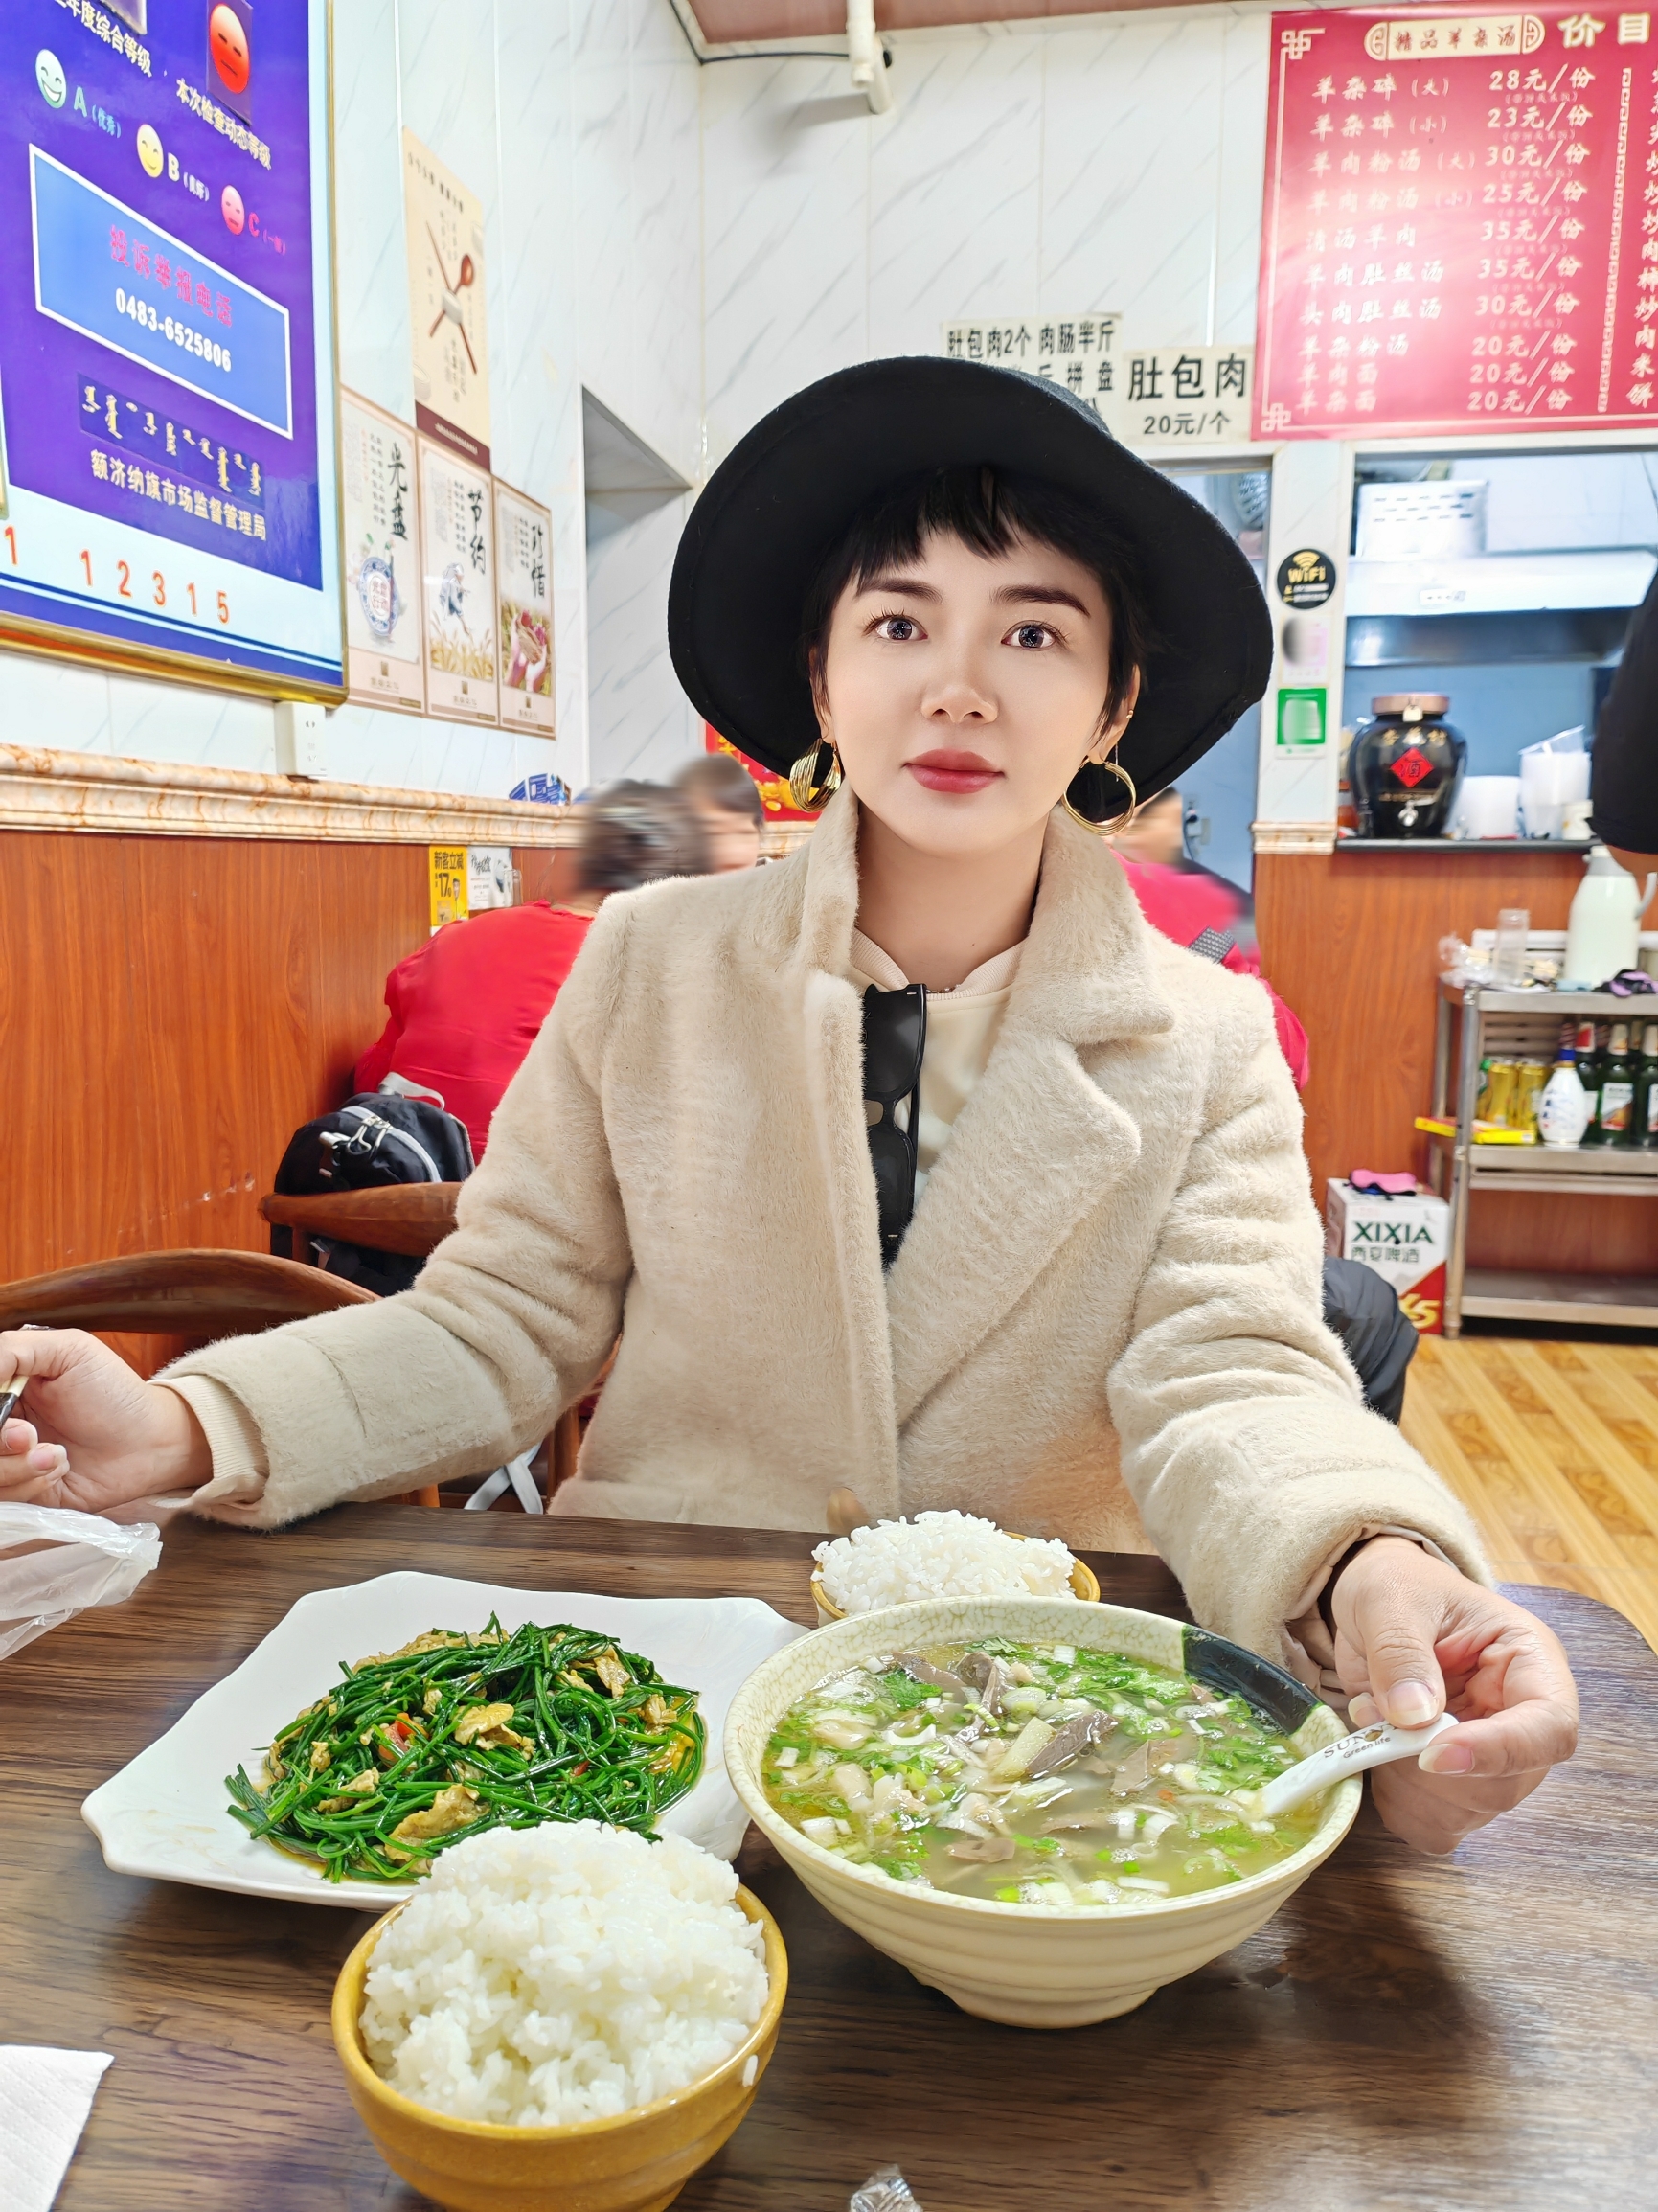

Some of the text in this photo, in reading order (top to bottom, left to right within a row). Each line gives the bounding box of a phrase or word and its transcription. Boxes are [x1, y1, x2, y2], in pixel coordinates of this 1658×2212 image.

[55, 0, 152, 78] 年度综合等级
[1557, 12, 1651, 49] 价目
[1488, 63, 1596, 93] 28元/份
[74, 86, 87, 118] A
[1487, 101, 1593, 131] 23元/份
[176, 77, 272, 171] 本次检查动态等级
[168, 152, 180, 182] B
[1485, 139, 1591, 170] 30元/份
[1482, 176, 1588, 207] 25元/份
[248, 212, 260, 238] C
[1479, 214, 1585, 244] 35元/份
[110, 223, 232, 328] 投诉举报电话
[1477, 252, 1583, 282] 35元/份
[1474, 288, 1580, 319] 30元/份
[115, 287, 231, 372] 0483-6525806
[1471, 330, 1578, 360] 20元/份
[1127, 353, 1247, 401] 肚包肉
[1469, 357, 1575, 388] 20元/份
[1466, 385, 1573, 416] 20元/份
[1143, 409, 1232, 435] 20元/个
[90, 447, 267, 541] 额济纳旗市场监督管理局
[1351, 1221, 1434, 1244] XIXIA
[1343, 1736, 1392, 1759] Green life
